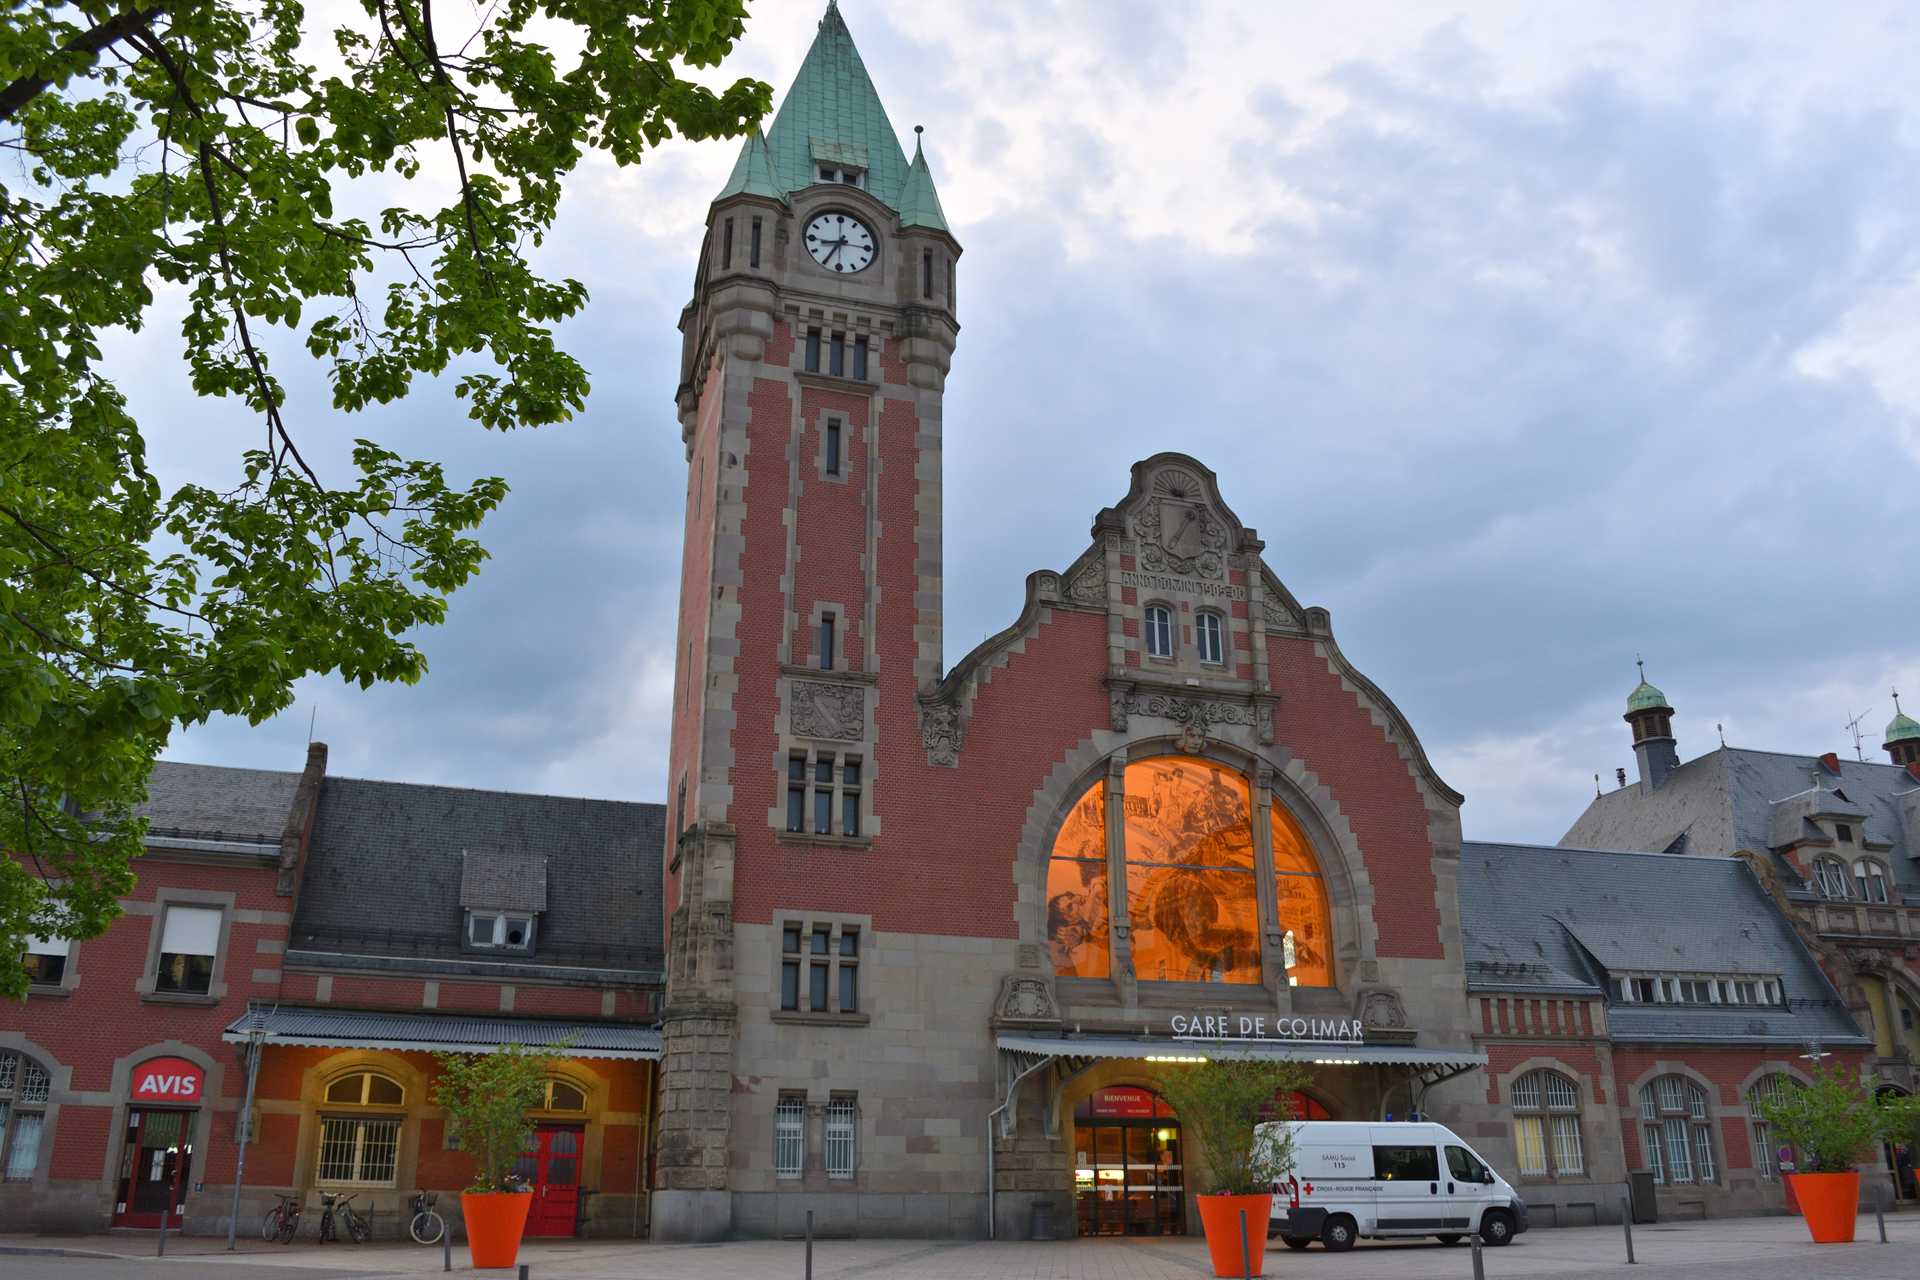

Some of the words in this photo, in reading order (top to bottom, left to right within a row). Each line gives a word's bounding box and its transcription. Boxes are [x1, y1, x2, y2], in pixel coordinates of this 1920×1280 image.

[1171, 1015, 1228, 1034] GARE
[1240, 1016, 1265, 1035] DE
[1276, 1018, 1364, 1037] COLMAR
[139, 1074, 196, 1095] AVIS
[1104, 1095, 1141, 1103] BIENVENUE
